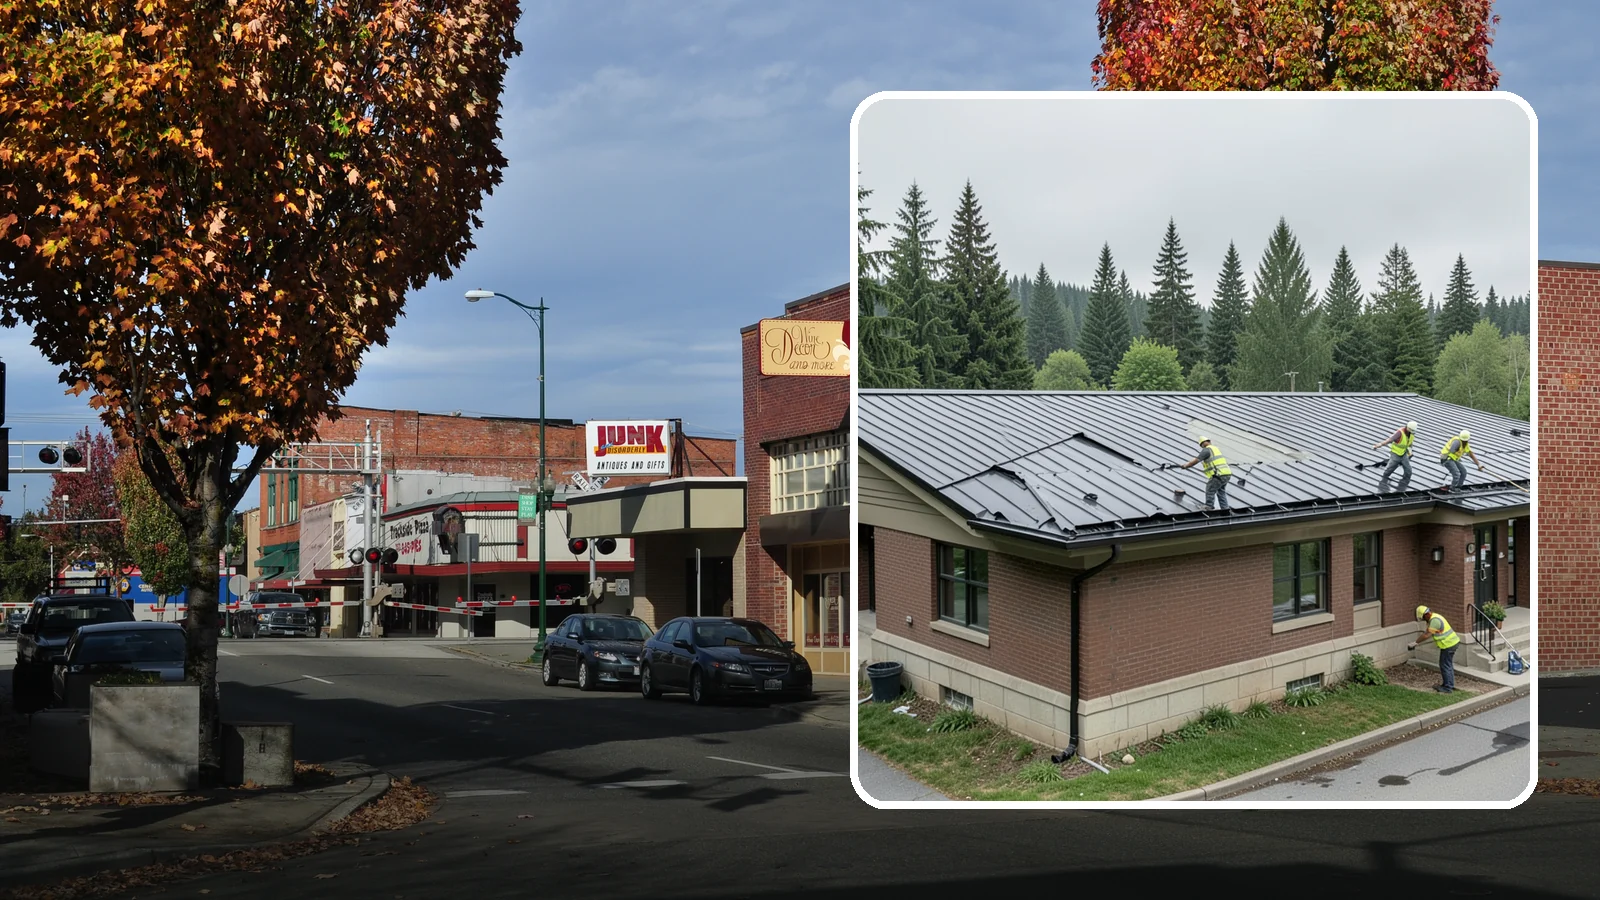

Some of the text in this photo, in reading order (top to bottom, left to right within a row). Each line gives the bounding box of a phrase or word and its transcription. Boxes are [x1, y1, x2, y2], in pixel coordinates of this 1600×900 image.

[595, 425, 666, 457] JUNK
[607, 446, 646, 454] DISORDERLY
[597, 460, 665, 470] ANTIQUES AND GIFTS
[390, 520, 429, 540] Trackside Pizza
